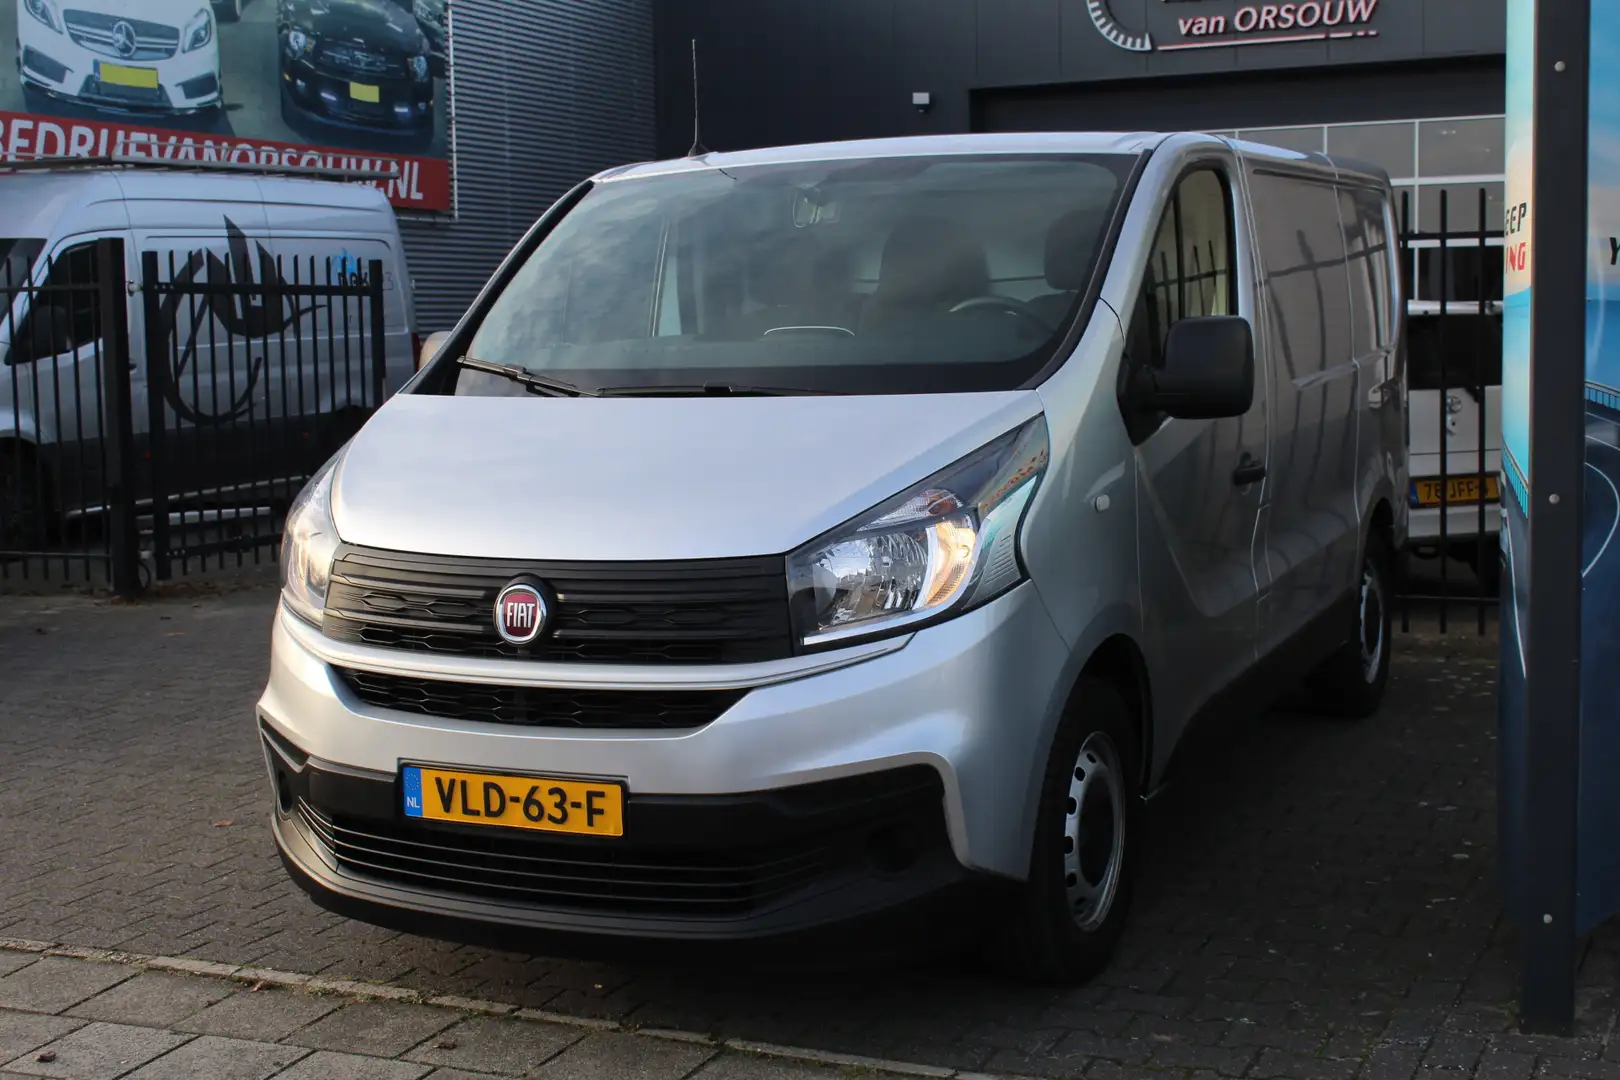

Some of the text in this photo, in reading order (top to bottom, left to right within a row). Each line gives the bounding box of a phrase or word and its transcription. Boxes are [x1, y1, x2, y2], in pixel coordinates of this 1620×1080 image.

[1177, 0, 1378, 36] van ORSOUW
[506, 601, 536, 628] FIAT
[406, 796, 421, 809] NL
[434, 776, 606, 828] VLD-63-F
